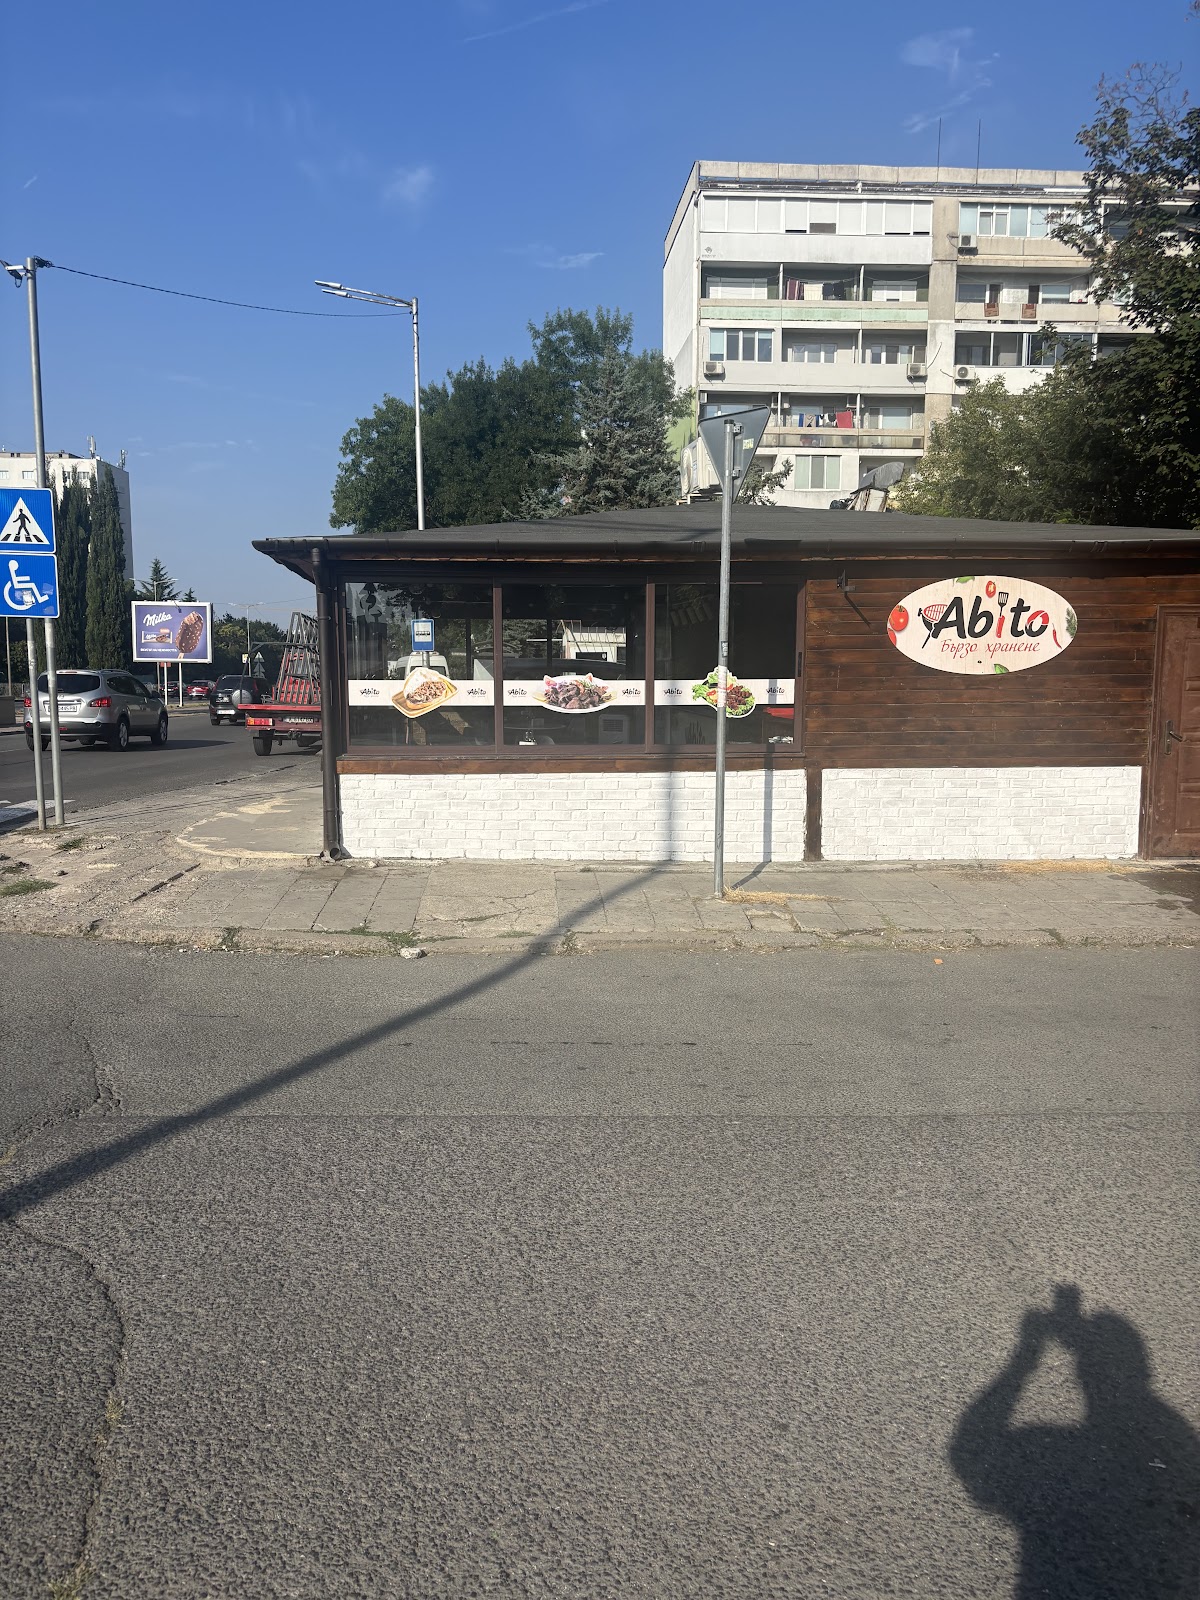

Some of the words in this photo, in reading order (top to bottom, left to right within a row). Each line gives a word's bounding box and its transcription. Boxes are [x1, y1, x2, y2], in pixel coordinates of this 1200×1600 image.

[143, 612, 173, 627] Milka
[931, 592, 1050, 639] Abito
[941, 639, 979, 659] Бързо
[985, 642, 1041, 659] хранене
